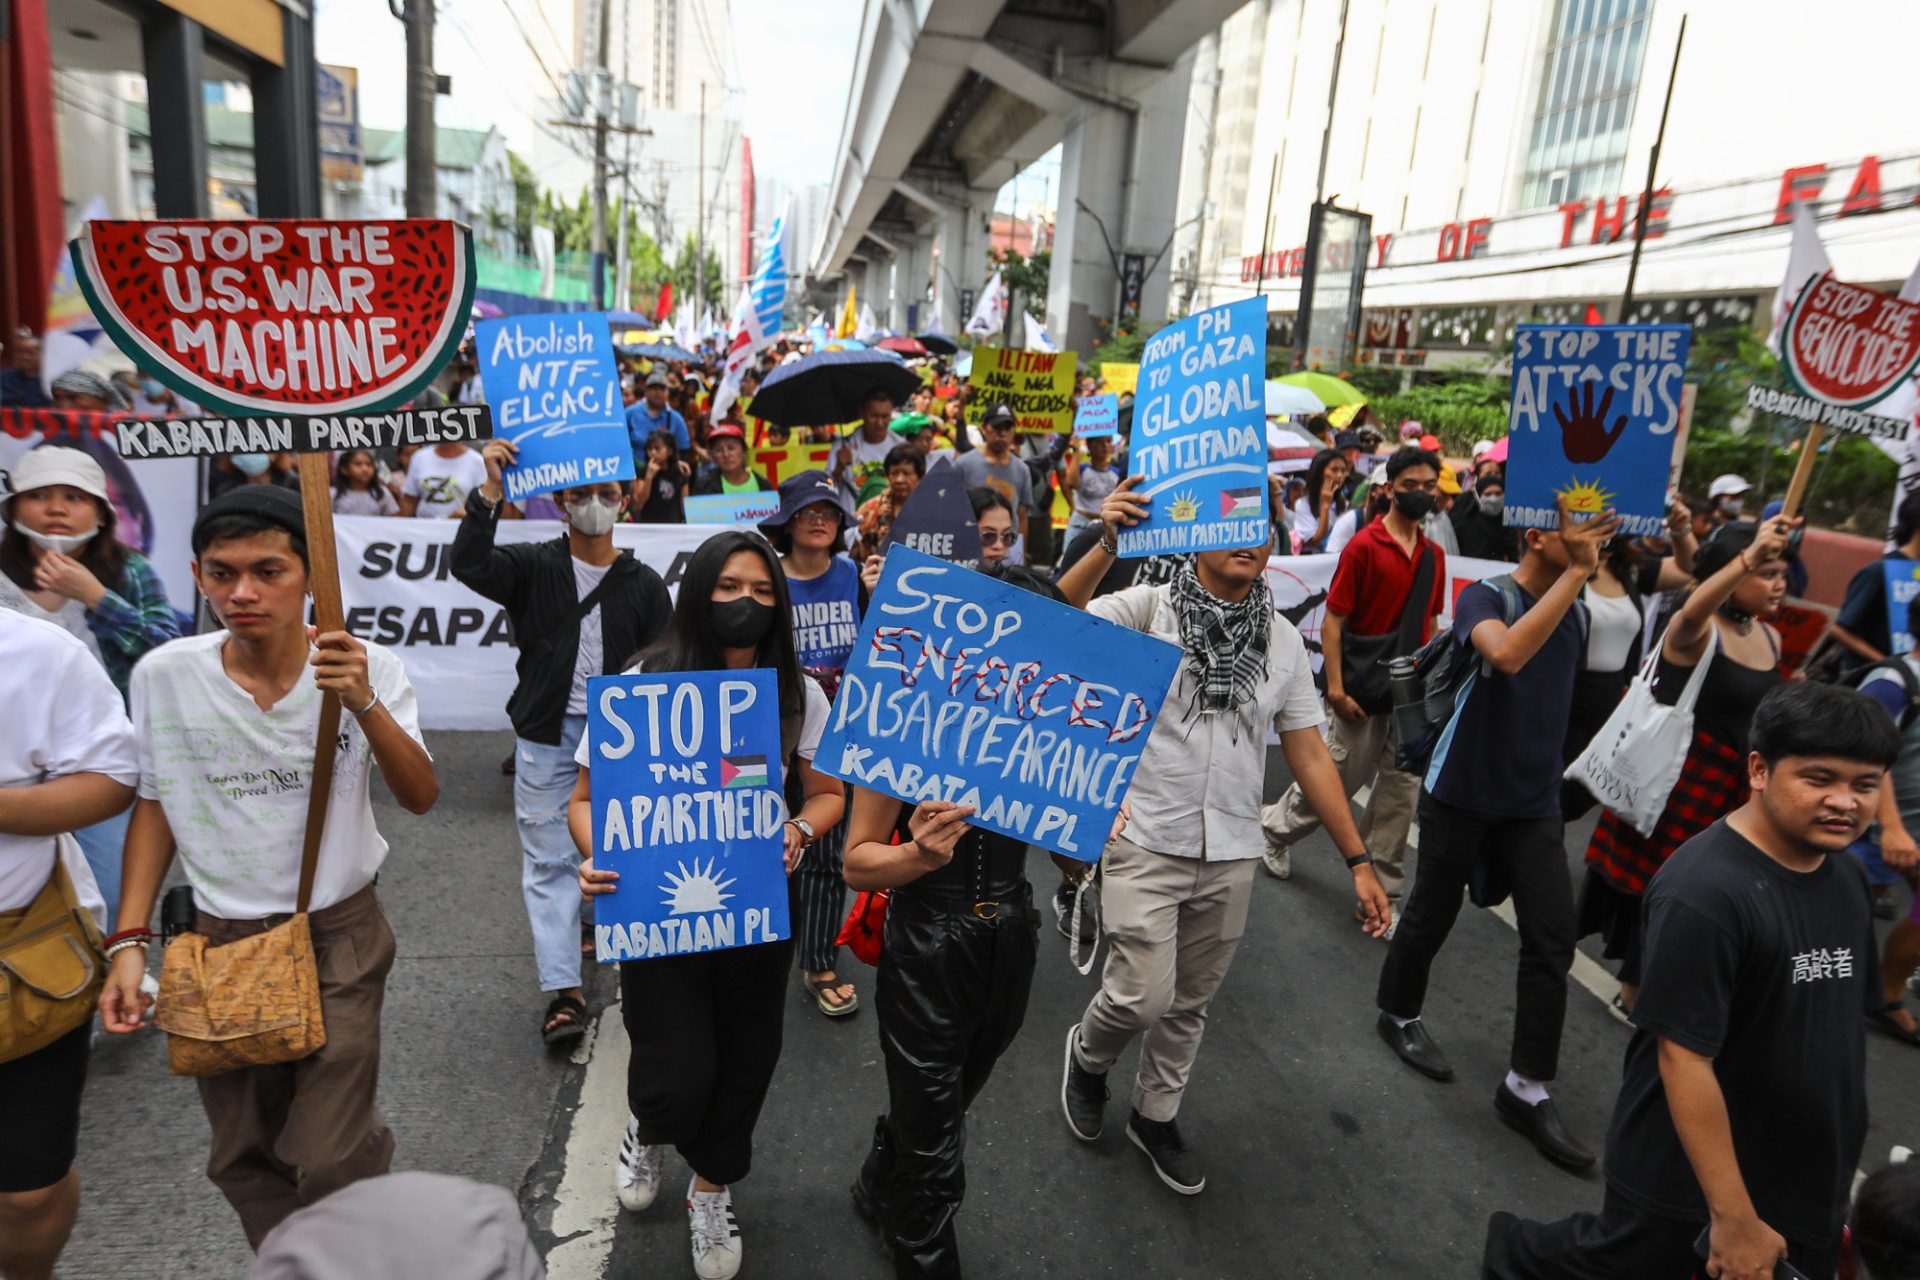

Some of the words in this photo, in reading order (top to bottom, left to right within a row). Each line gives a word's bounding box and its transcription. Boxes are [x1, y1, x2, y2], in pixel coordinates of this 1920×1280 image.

[1437, 218, 1492, 262] OF
[1558, 188, 1672, 248] THE
[1774, 156, 1920, 225] EA
[145, 225, 284, 263] STOP
[297, 225, 395, 266] THE
[162, 265, 258, 314] U.S.
[263, 265, 376, 314] WAR
[1813, 281, 1875, 317] STOP
[1873, 300, 1919, 338] THE
[170, 317, 407, 392] MACHINE
[491, 319, 593, 367] Abolish
[997, 348, 1058, 374] ILITAW
[1141, 329, 1186, 369] FROM
[1197, 308, 1231, 342] PH
[1149, 364, 1171, 391] TO
[1180, 334, 1256, 377] GAZA
[1517, 331, 1600, 360] STOP
[1614, 331, 1682, 361] THE
[1799, 312, 1911, 386] GENOCIDE!
[518, 359, 601, 391] NTF-
[984, 371, 1015, 390] ANG
[1024, 376, 1055, 391] MGA
[1510, 362, 1683, 435] ATTACKS
[500, 380, 614, 429] ELCAC!
[1142, 373, 1261, 437] GLOBAL
[1747, 385, 1822, 422] KABATAAN
[1821, 406, 1908, 440] PARTYLIST
[116, 417, 293, 457] KABATAAN
[308, 406, 483, 449] PARTYLIST
[1135, 424, 1261, 482] INTIFADA
[507, 460, 579, 498] KABATAAN
[905, 533, 954, 555] FREE
[1117, 526, 1188, 555] KABATAAN
[1190, 519, 1266, 546] PARTYLIST
[346, 606, 519, 647] ESAPA
[792, 600, 853, 627] NDER
[880, 567, 1022, 648] STOP
[809, 648, 851, 660] COMPAN
[867, 626, 1152, 744] ENFORCED
[600, 681, 757, 759] STOP
[834, 673, 1139, 808] DISAPPEARANCE
[242, 772, 261, 784] Do
[263, 769, 300, 787] Not
[648, 761, 709, 785] THE
[840, 742, 1034, 834] KABATAAN
[1033, 806, 1078, 851] PL
[603, 790, 784, 851] APARTHEID
[595, 912, 735, 962] KABATAAN
[743, 907, 778, 944] PL
[1792, 947, 1853, 984] 高齢者
